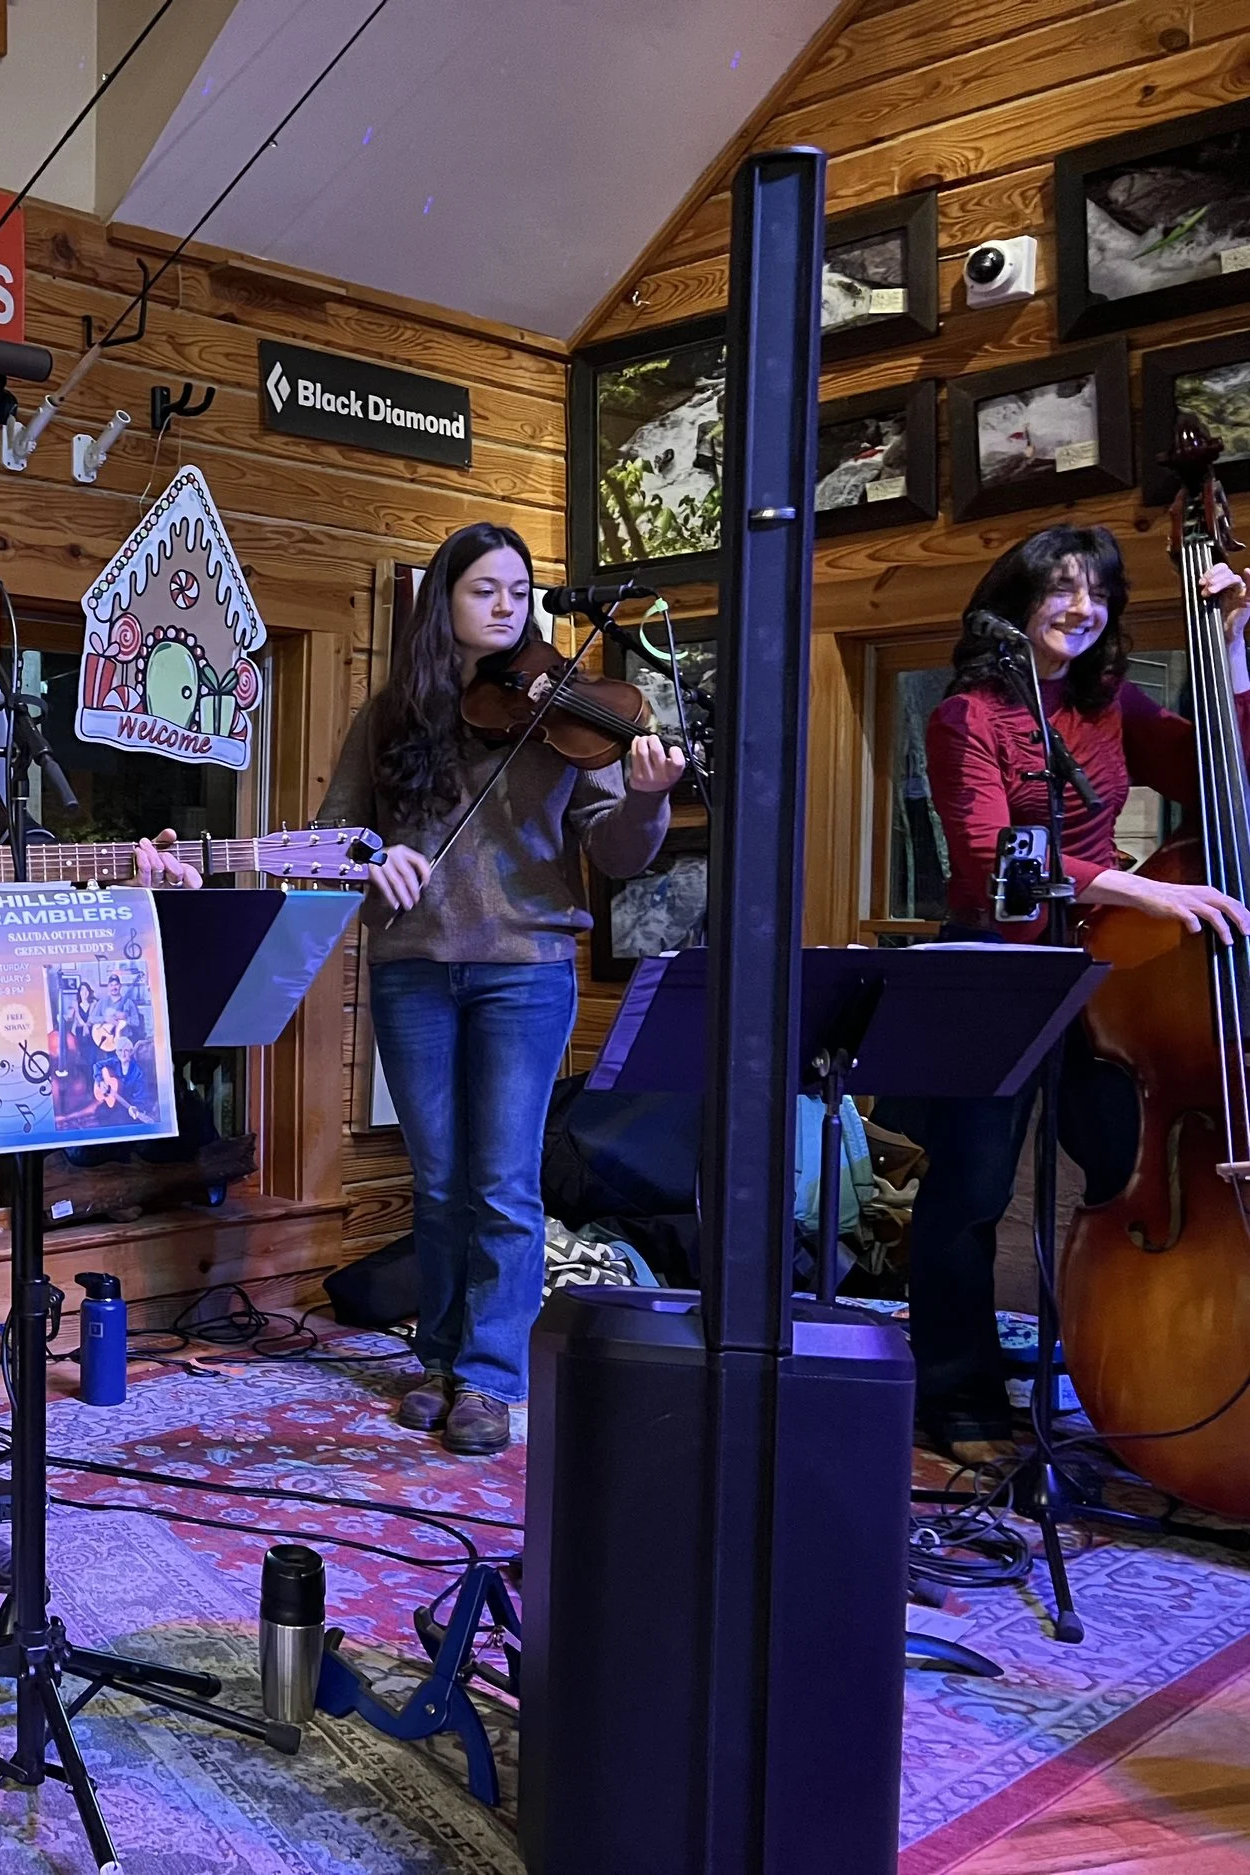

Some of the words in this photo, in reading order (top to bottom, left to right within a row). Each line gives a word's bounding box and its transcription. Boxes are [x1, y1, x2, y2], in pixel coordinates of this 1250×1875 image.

[297, 379, 365, 419] Black
[367, 395, 466, 441] Diamond
[116, 714, 213, 756] Welcome
[7, 931, 50, 943] SALUDA
[14, 945, 47, 957] GREEN
[47, 943, 79, 955] RIVER
